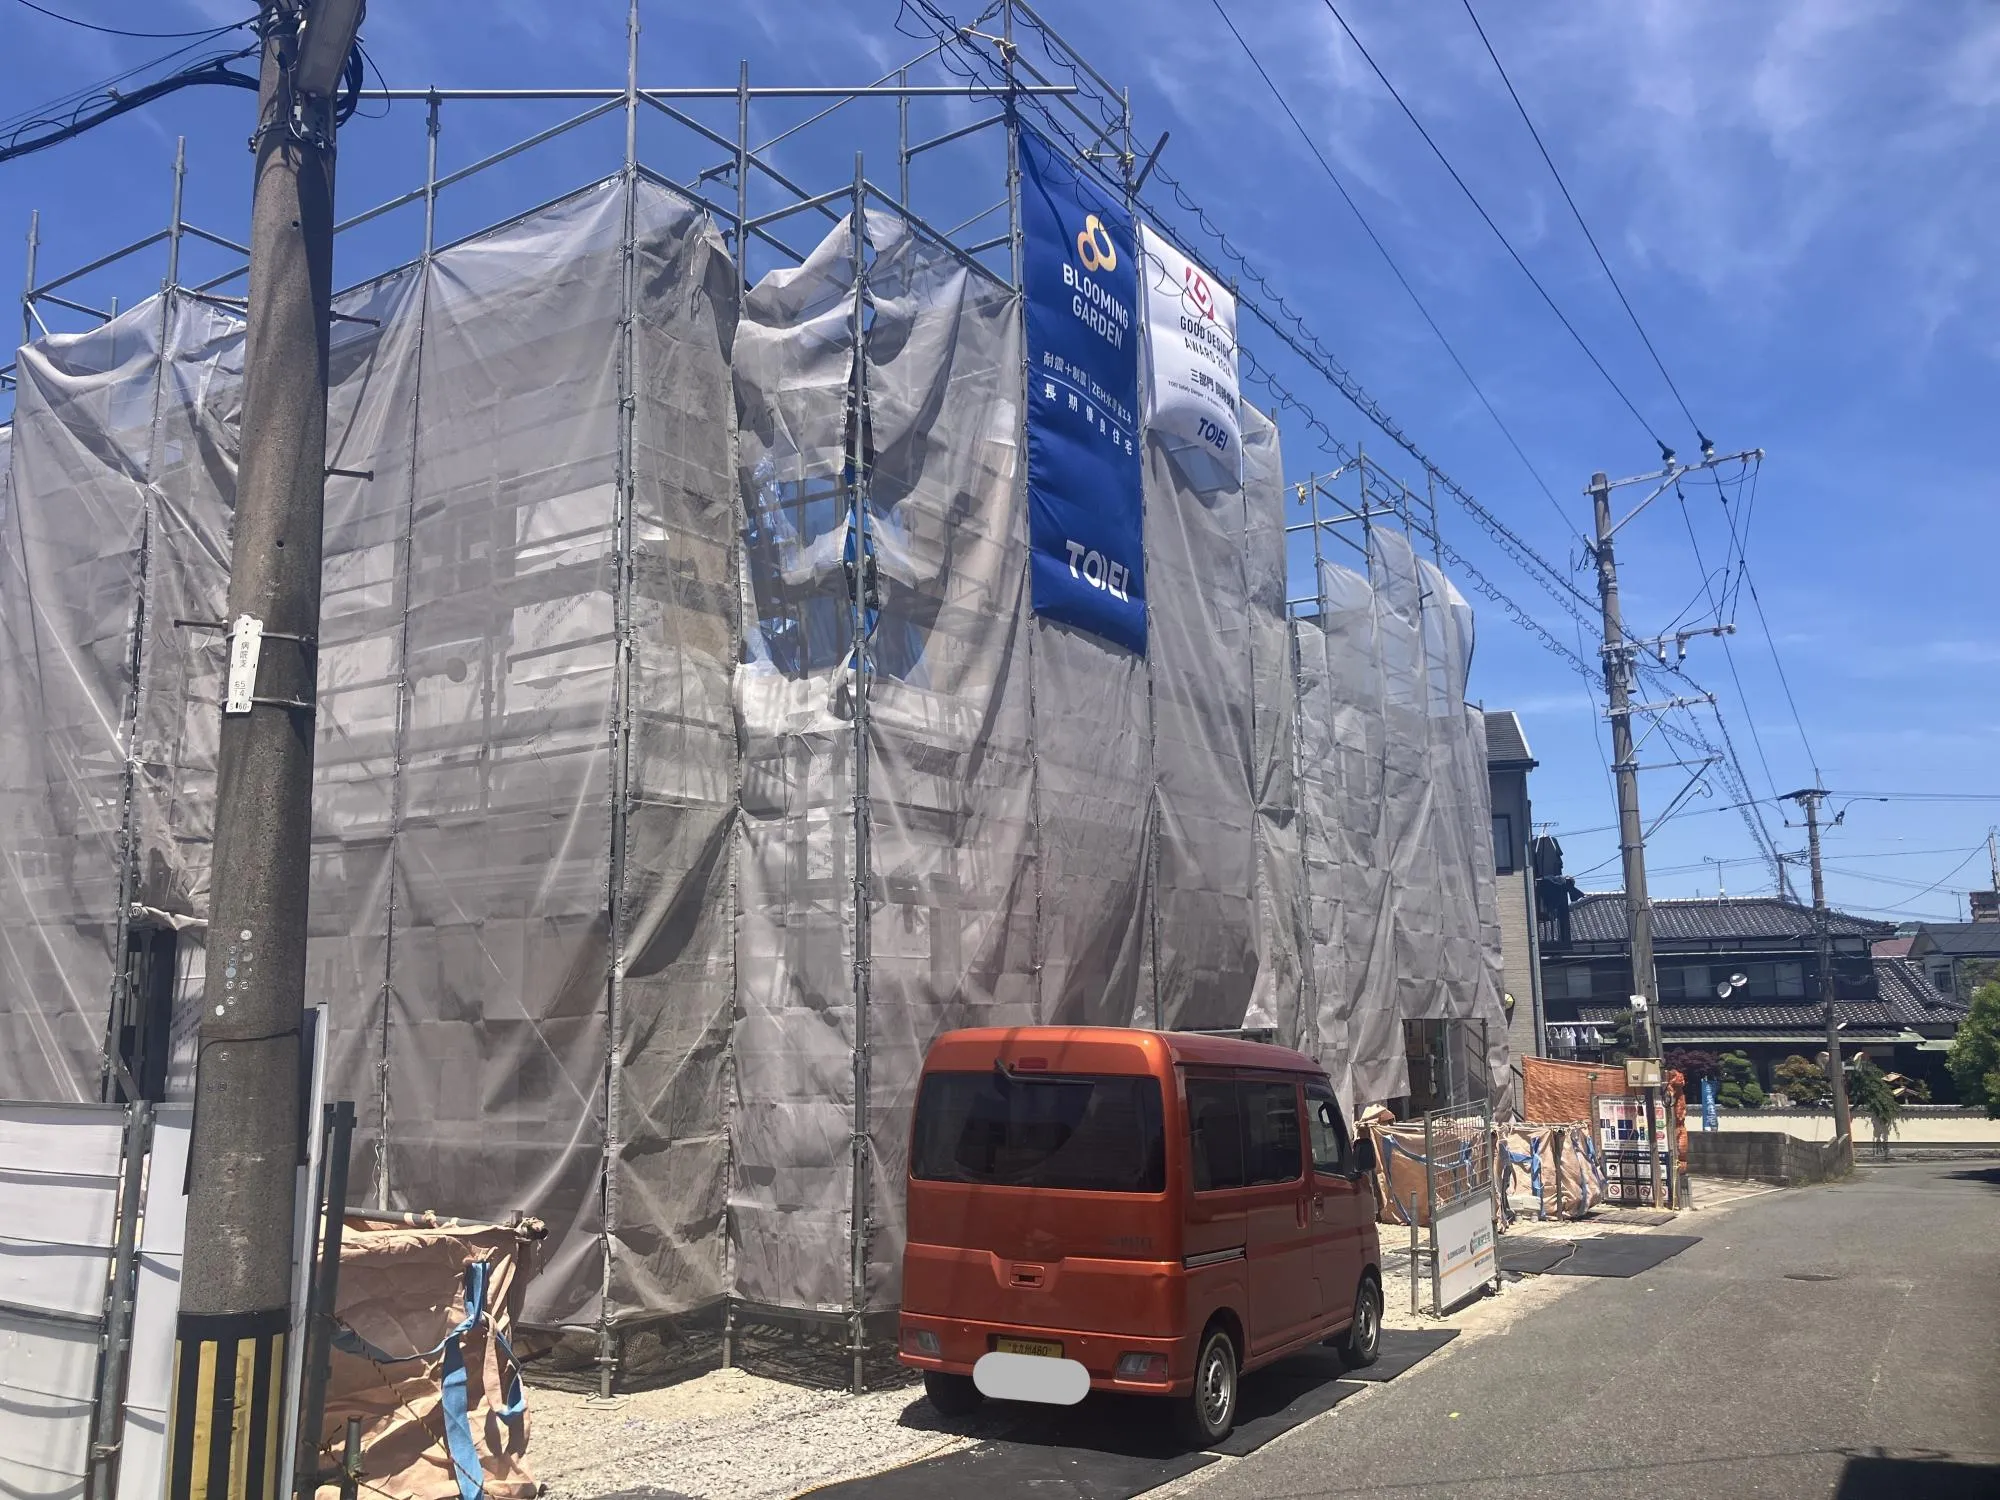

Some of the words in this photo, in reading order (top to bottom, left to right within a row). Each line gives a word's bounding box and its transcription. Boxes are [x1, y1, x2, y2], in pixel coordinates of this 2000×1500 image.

[1063, 262, 1129, 330] BLOOMING
[1072, 294, 1123, 351] GARDEN
[1180, 316, 1205, 340] GOOD
[1207, 330, 1231, 361] DESIGN
[1184, 336, 1216, 364] AWARD
[1197, 417, 1228, 451] TOEI
[1066, 539, 1129, 603] TOEI
